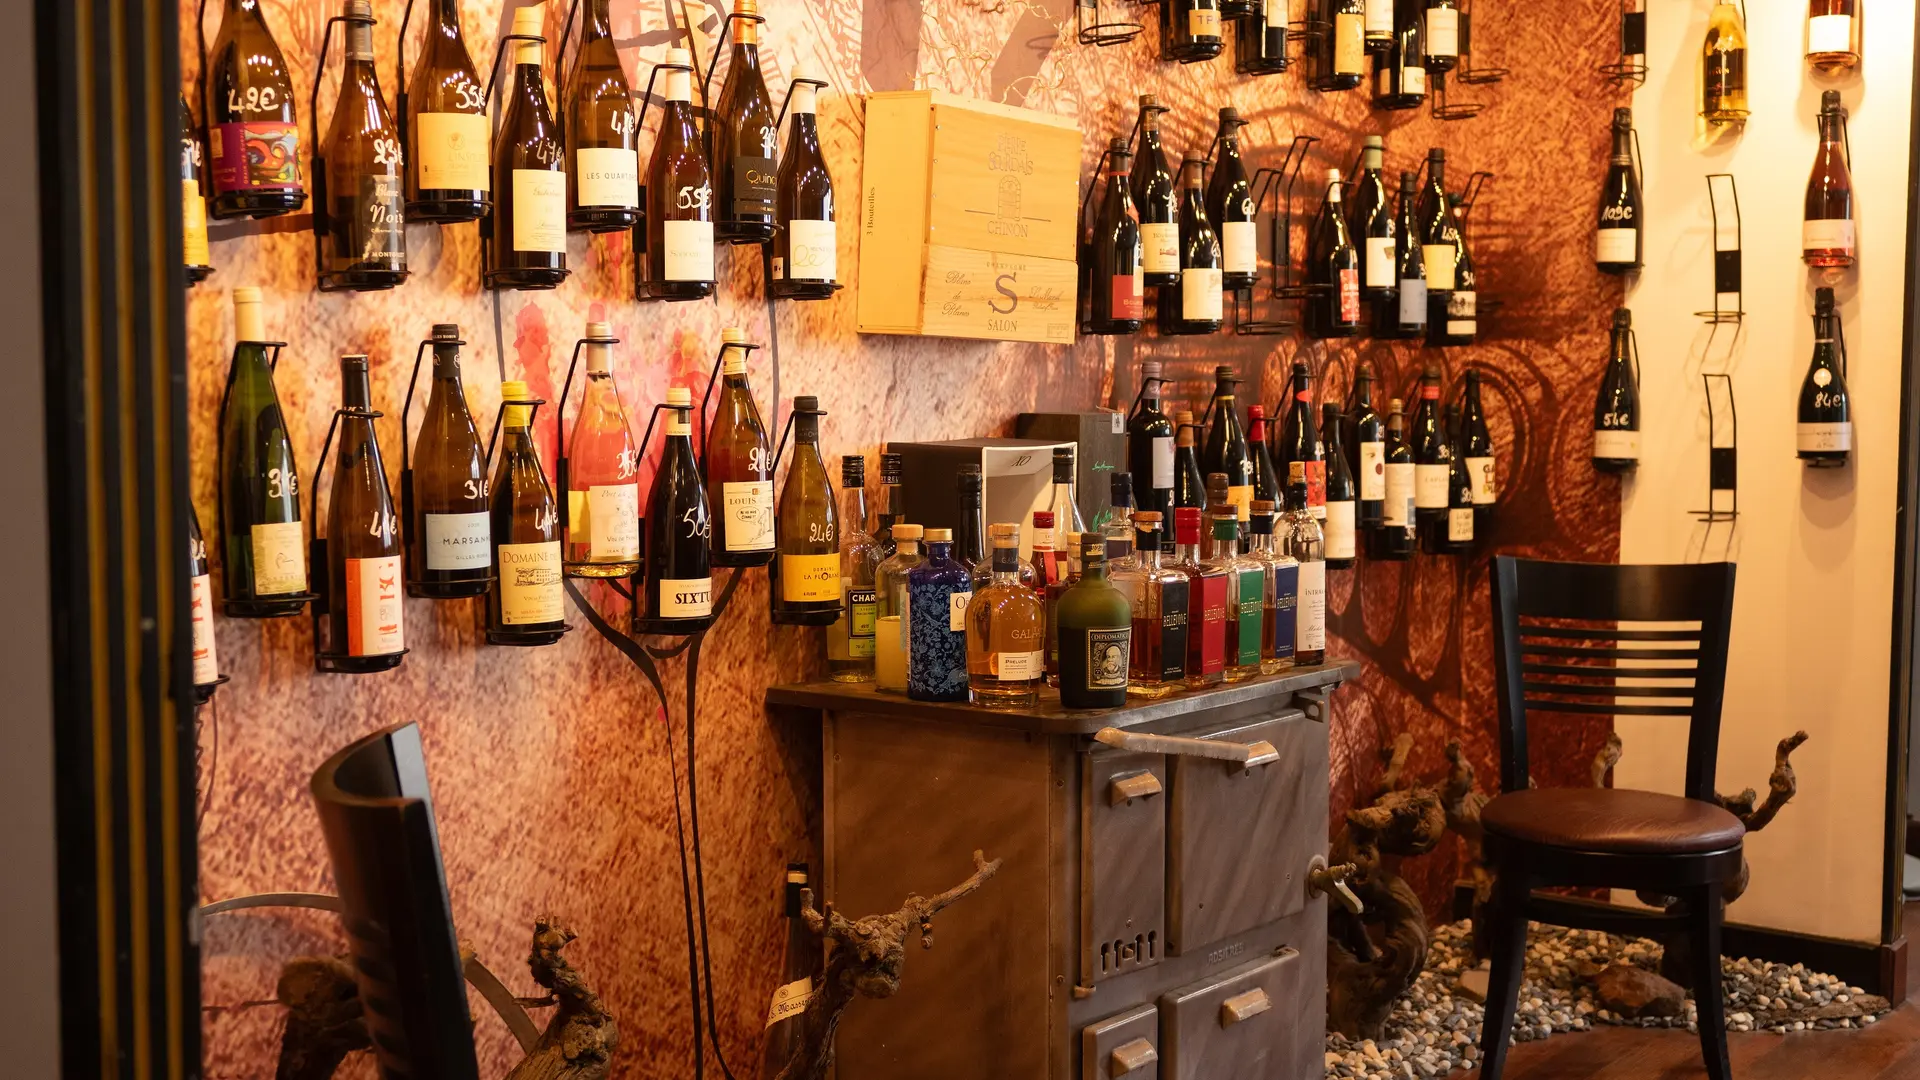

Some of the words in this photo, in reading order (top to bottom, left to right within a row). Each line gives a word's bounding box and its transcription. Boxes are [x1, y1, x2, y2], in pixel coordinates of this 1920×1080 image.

[227, 86, 279, 113] 42€
[586, 172, 600, 180] LES
[369, 204, 405, 225] Noir
[866, 186, 876, 230] Bouteilles
[866, 229, 873, 237] 3
[987, 220, 1028, 238] CHINON
[987, 318, 1018, 333] SALON
[1010, 455, 1032, 467] XO
[463, 479, 489, 500] 31€
[729, 497, 757, 506] LOUIS
[808, 522, 834, 543] 24€
[502, 551, 549, 564] DOMAINE
